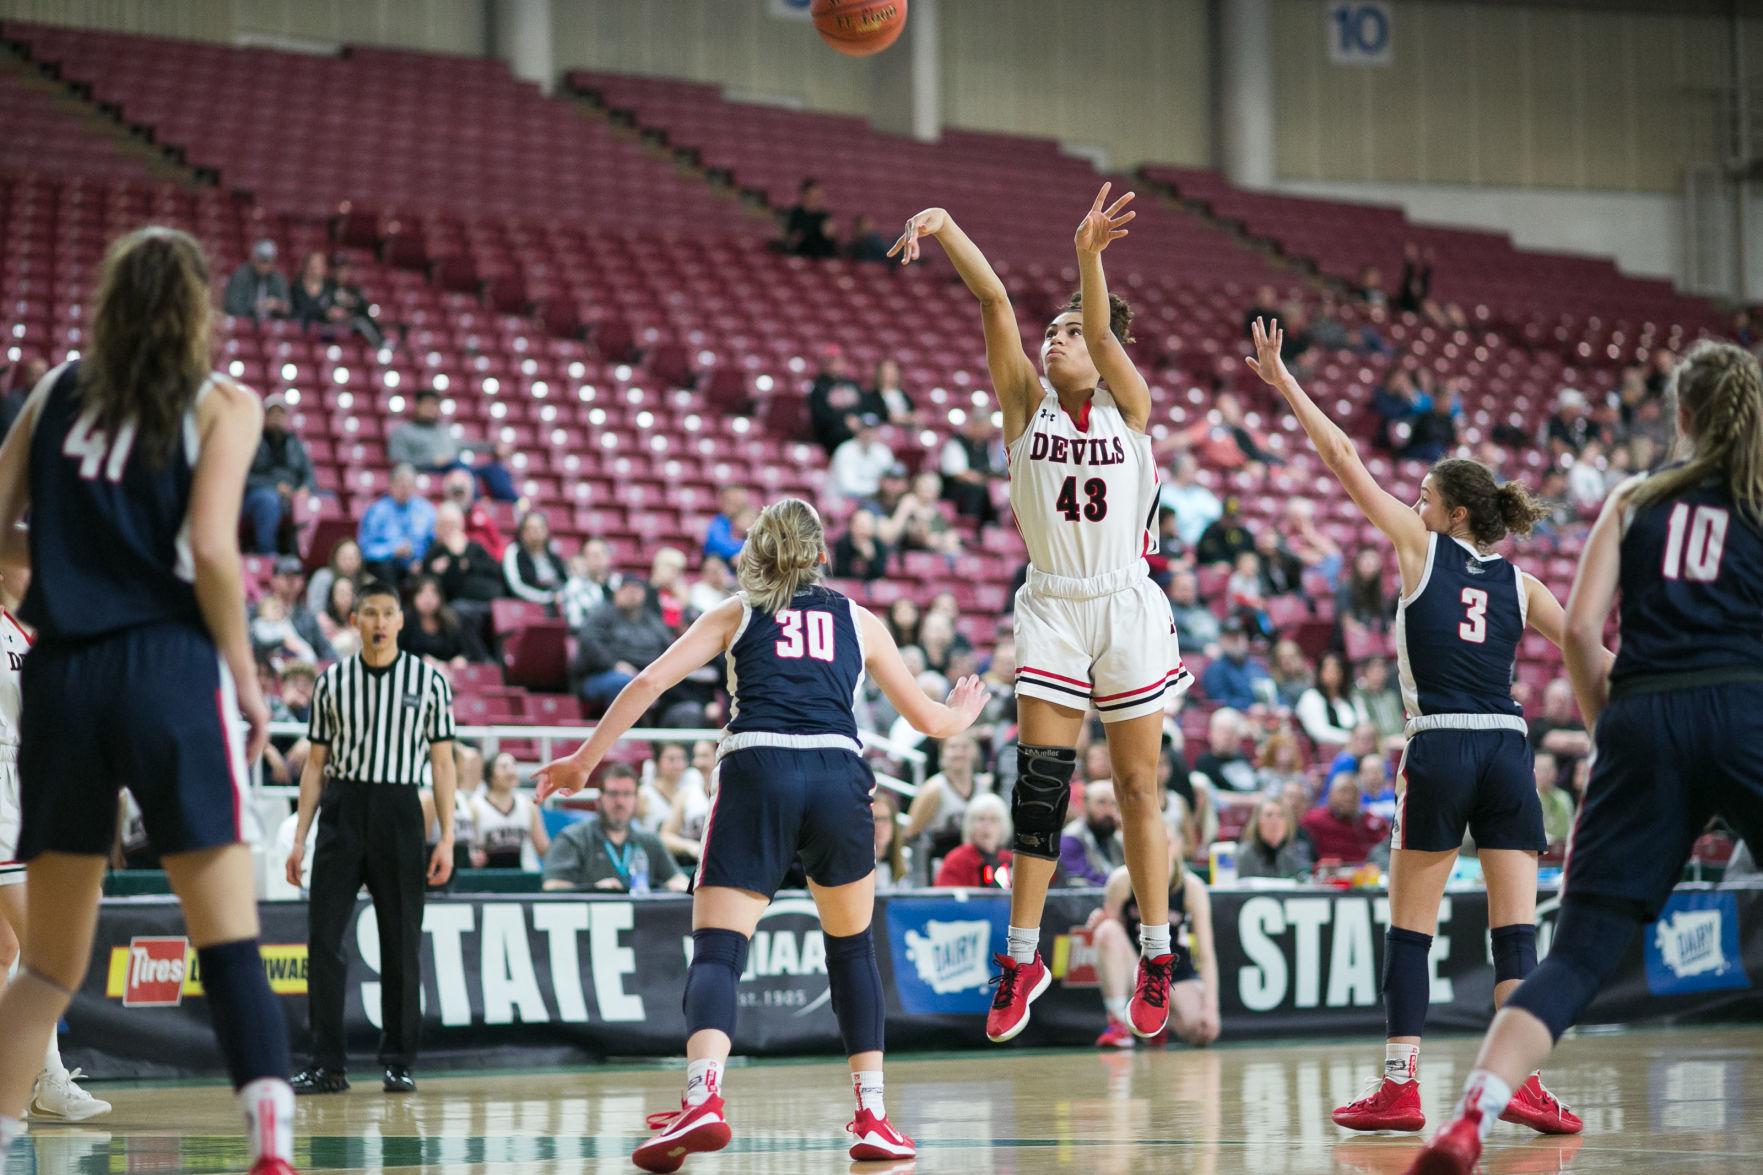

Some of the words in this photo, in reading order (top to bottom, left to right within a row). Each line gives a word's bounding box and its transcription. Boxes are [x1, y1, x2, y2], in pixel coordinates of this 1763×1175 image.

[1335, 6, 1387, 54] 10
[1030, 432, 1125, 466] DEVILS
[1056, 475, 1108, 523] 43
[1661, 501, 1729, 582] 10
[774, 609, 835, 663] 30
[1458, 587, 1488, 643] 3
[131, 947, 183, 989] Tires
[1238, 896, 1455, 1012] STAE
